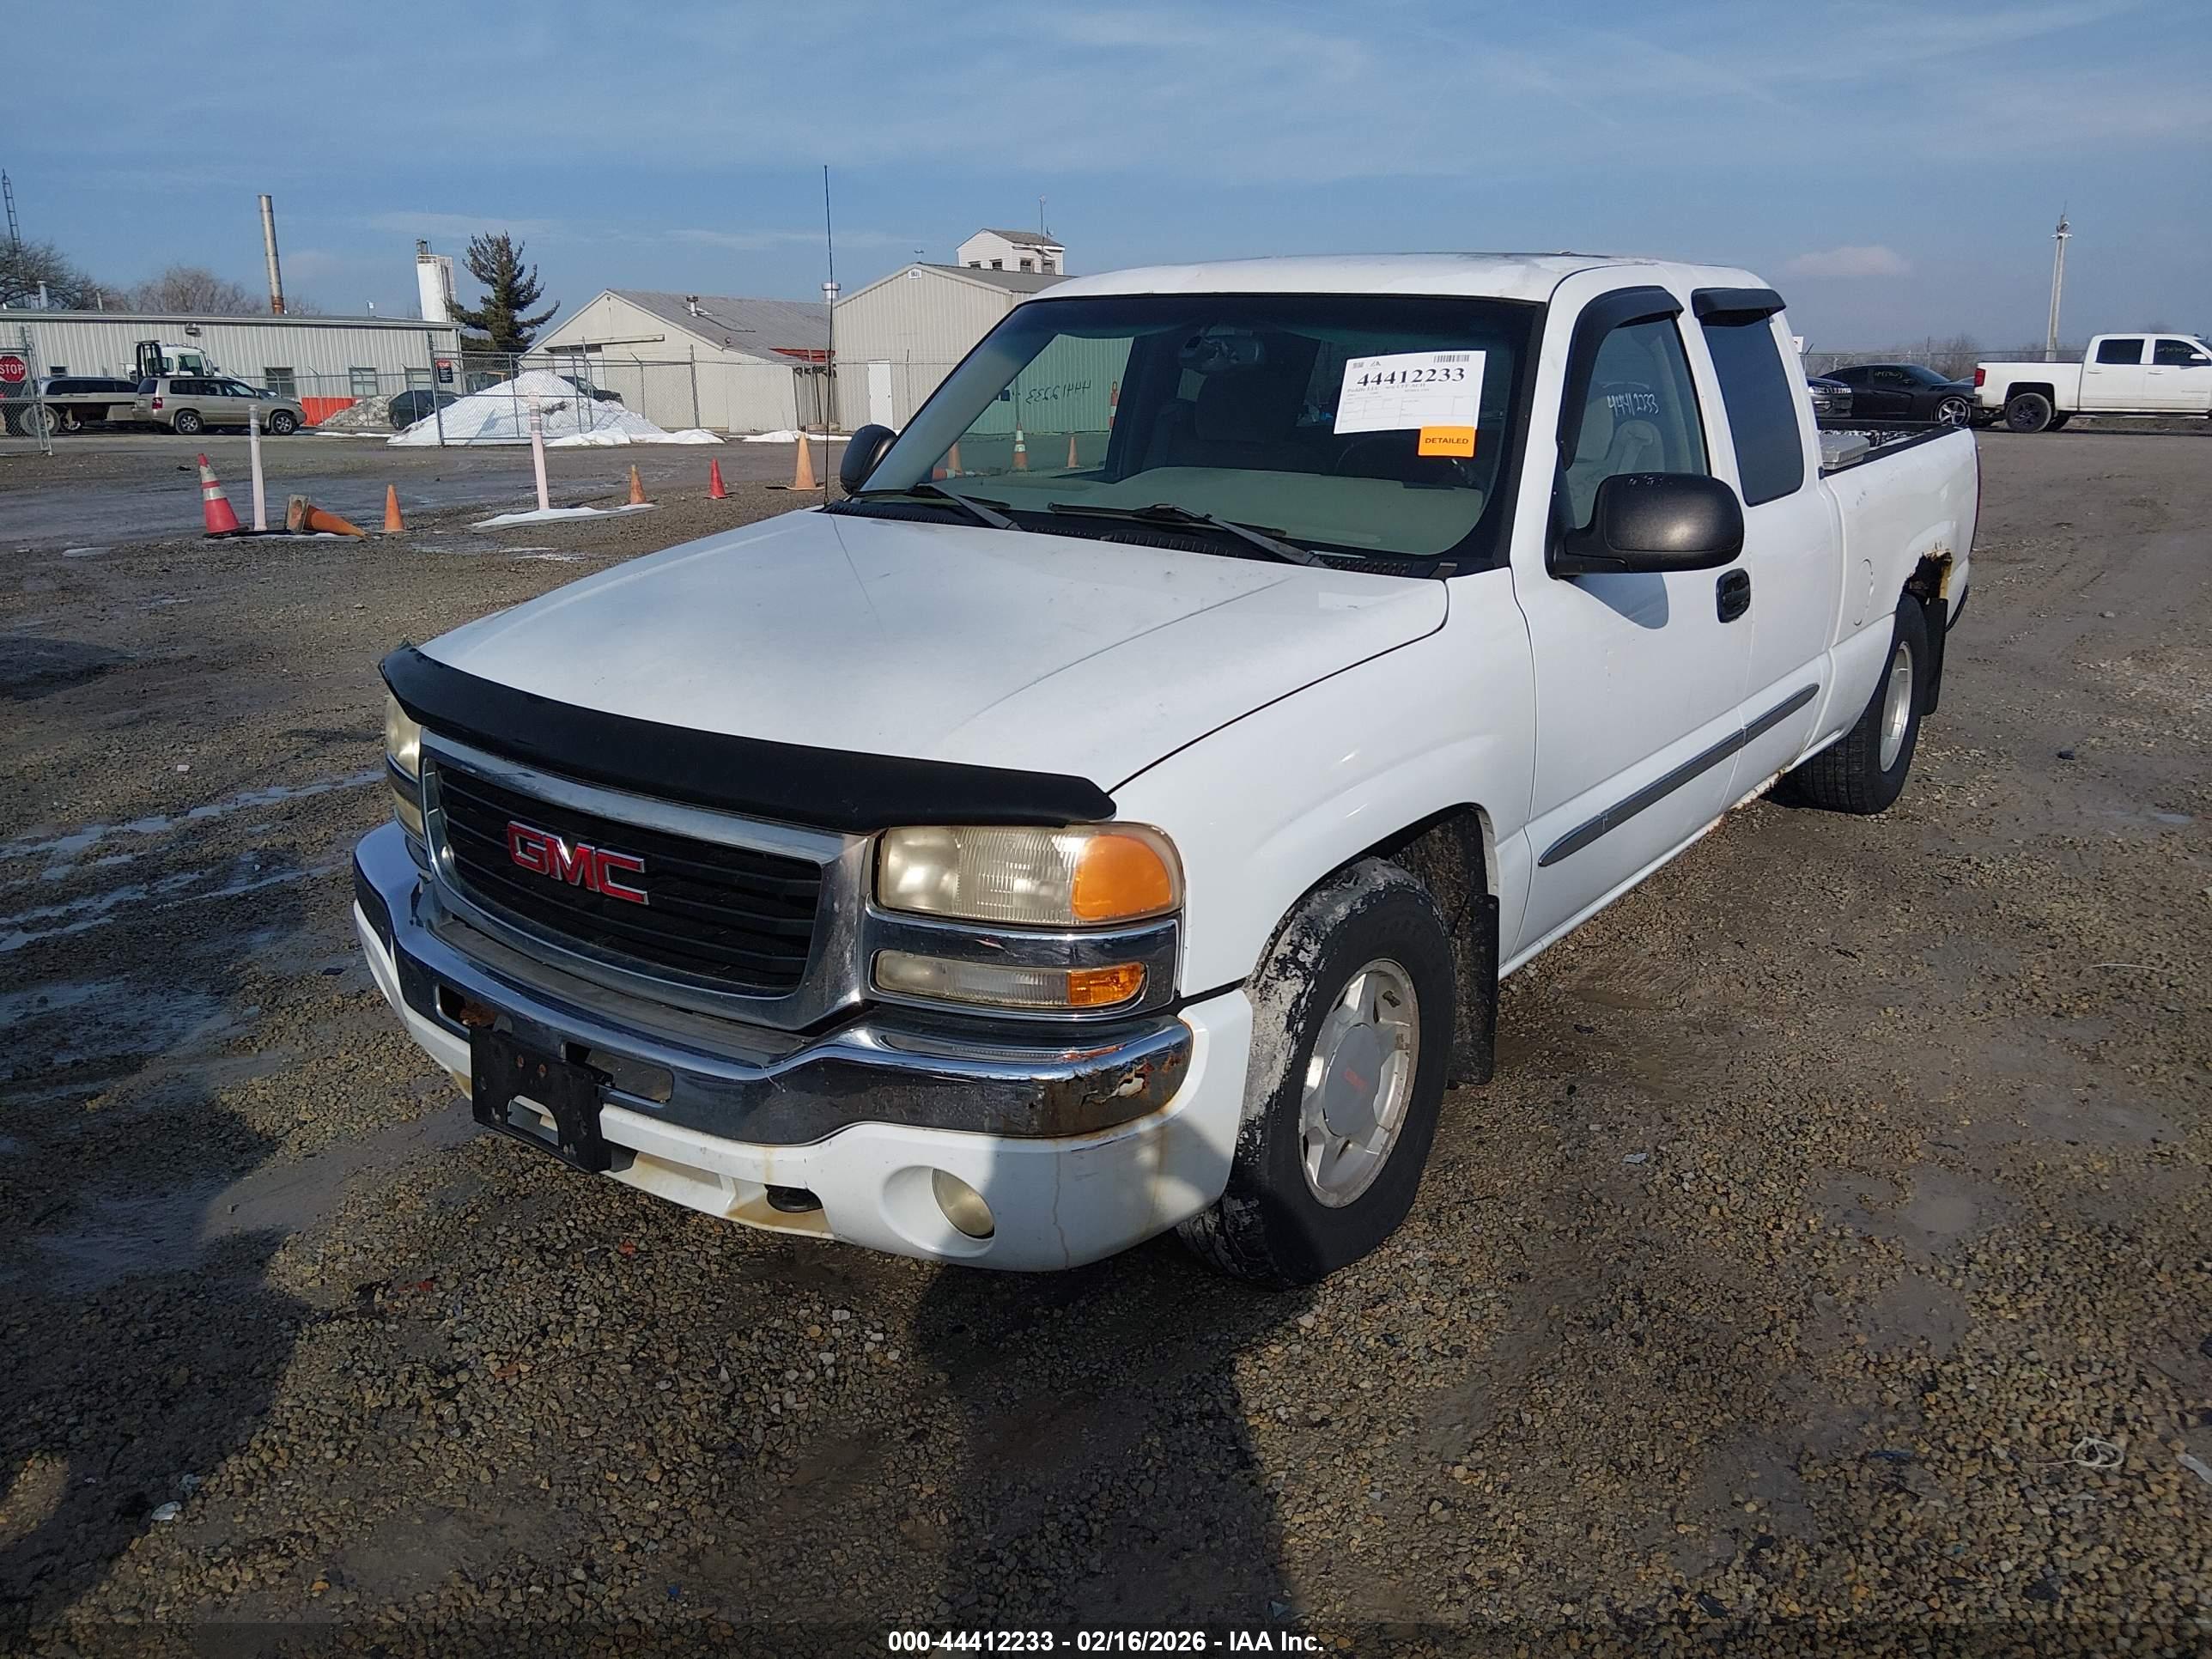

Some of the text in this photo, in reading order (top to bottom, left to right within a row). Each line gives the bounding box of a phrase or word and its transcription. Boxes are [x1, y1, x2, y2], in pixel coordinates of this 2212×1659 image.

[0, 363, 24, 374] STOP
[1356, 368, 1466, 386] 44412233
[1607, 392, 1659, 417] 44412233
[507, 820, 650, 905] GMC
